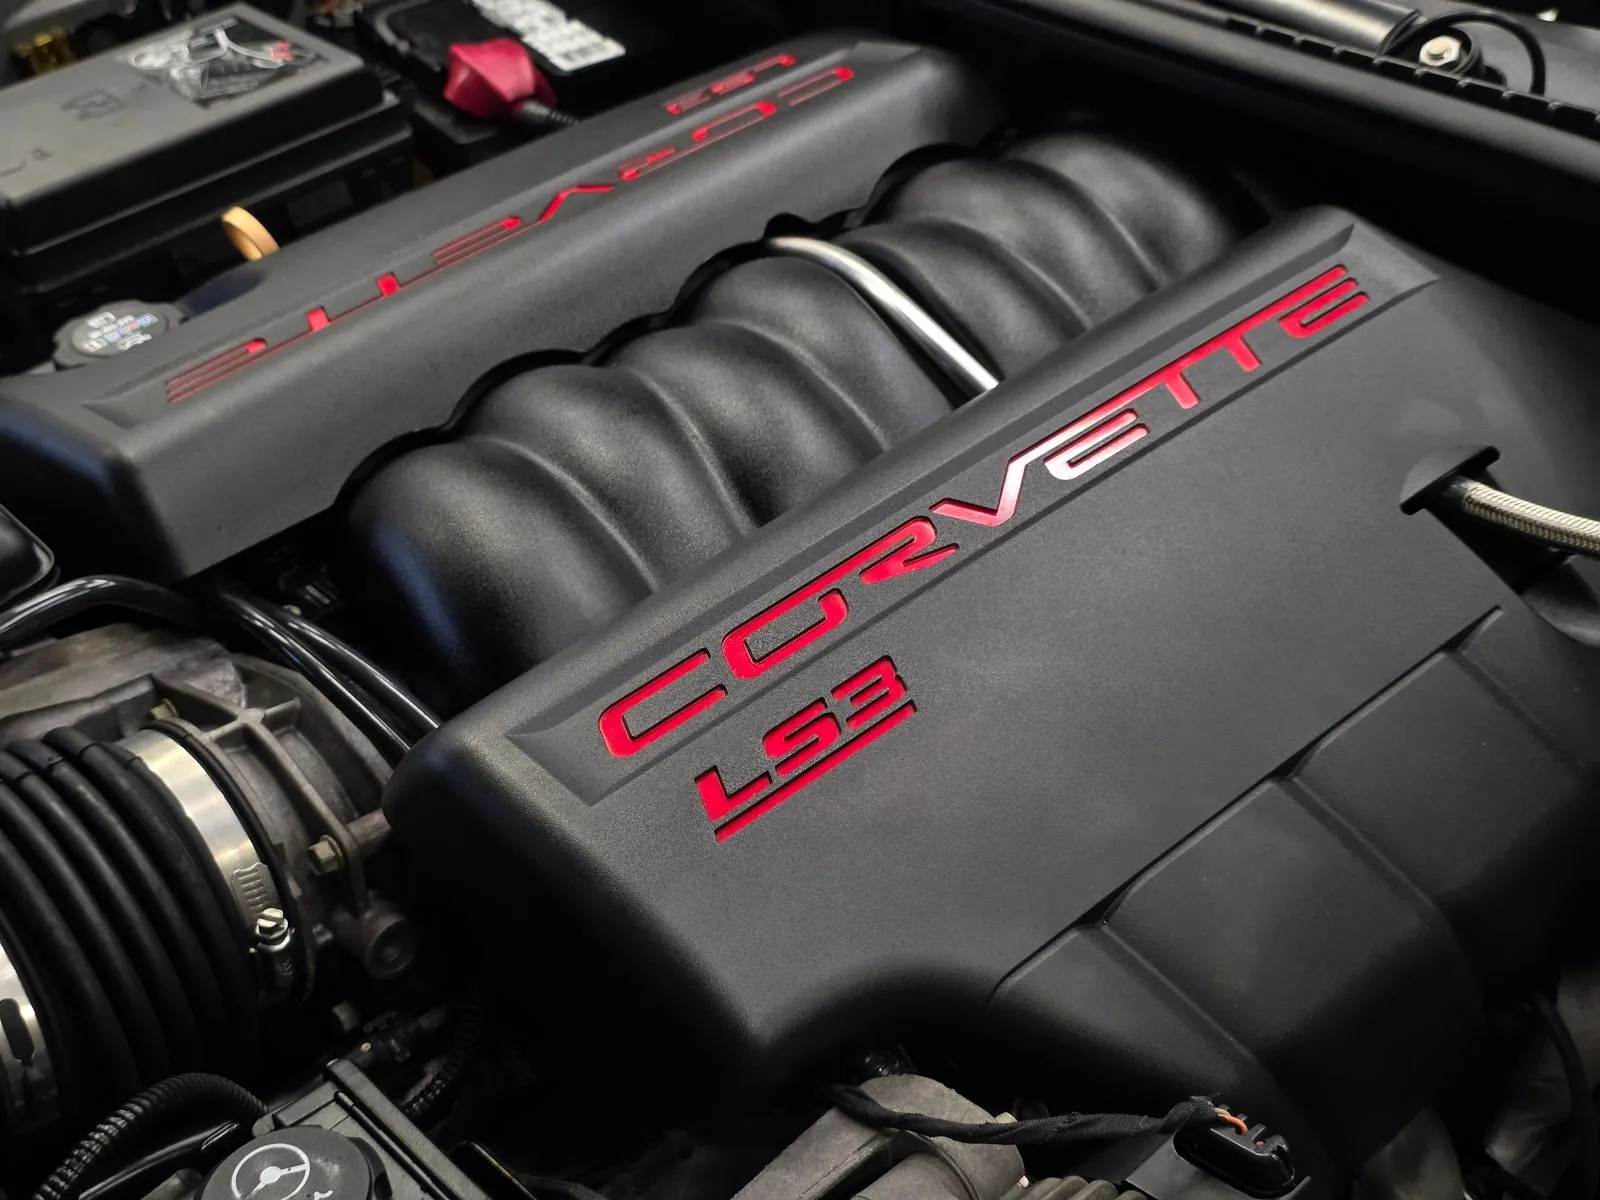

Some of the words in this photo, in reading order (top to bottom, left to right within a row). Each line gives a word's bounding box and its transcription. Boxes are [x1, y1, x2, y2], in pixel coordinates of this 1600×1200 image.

[166, 66, 855, 403] CORVETTE
[598, 264, 1370, 759] CORVETTE
[694, 655, 912, 828] LS3
